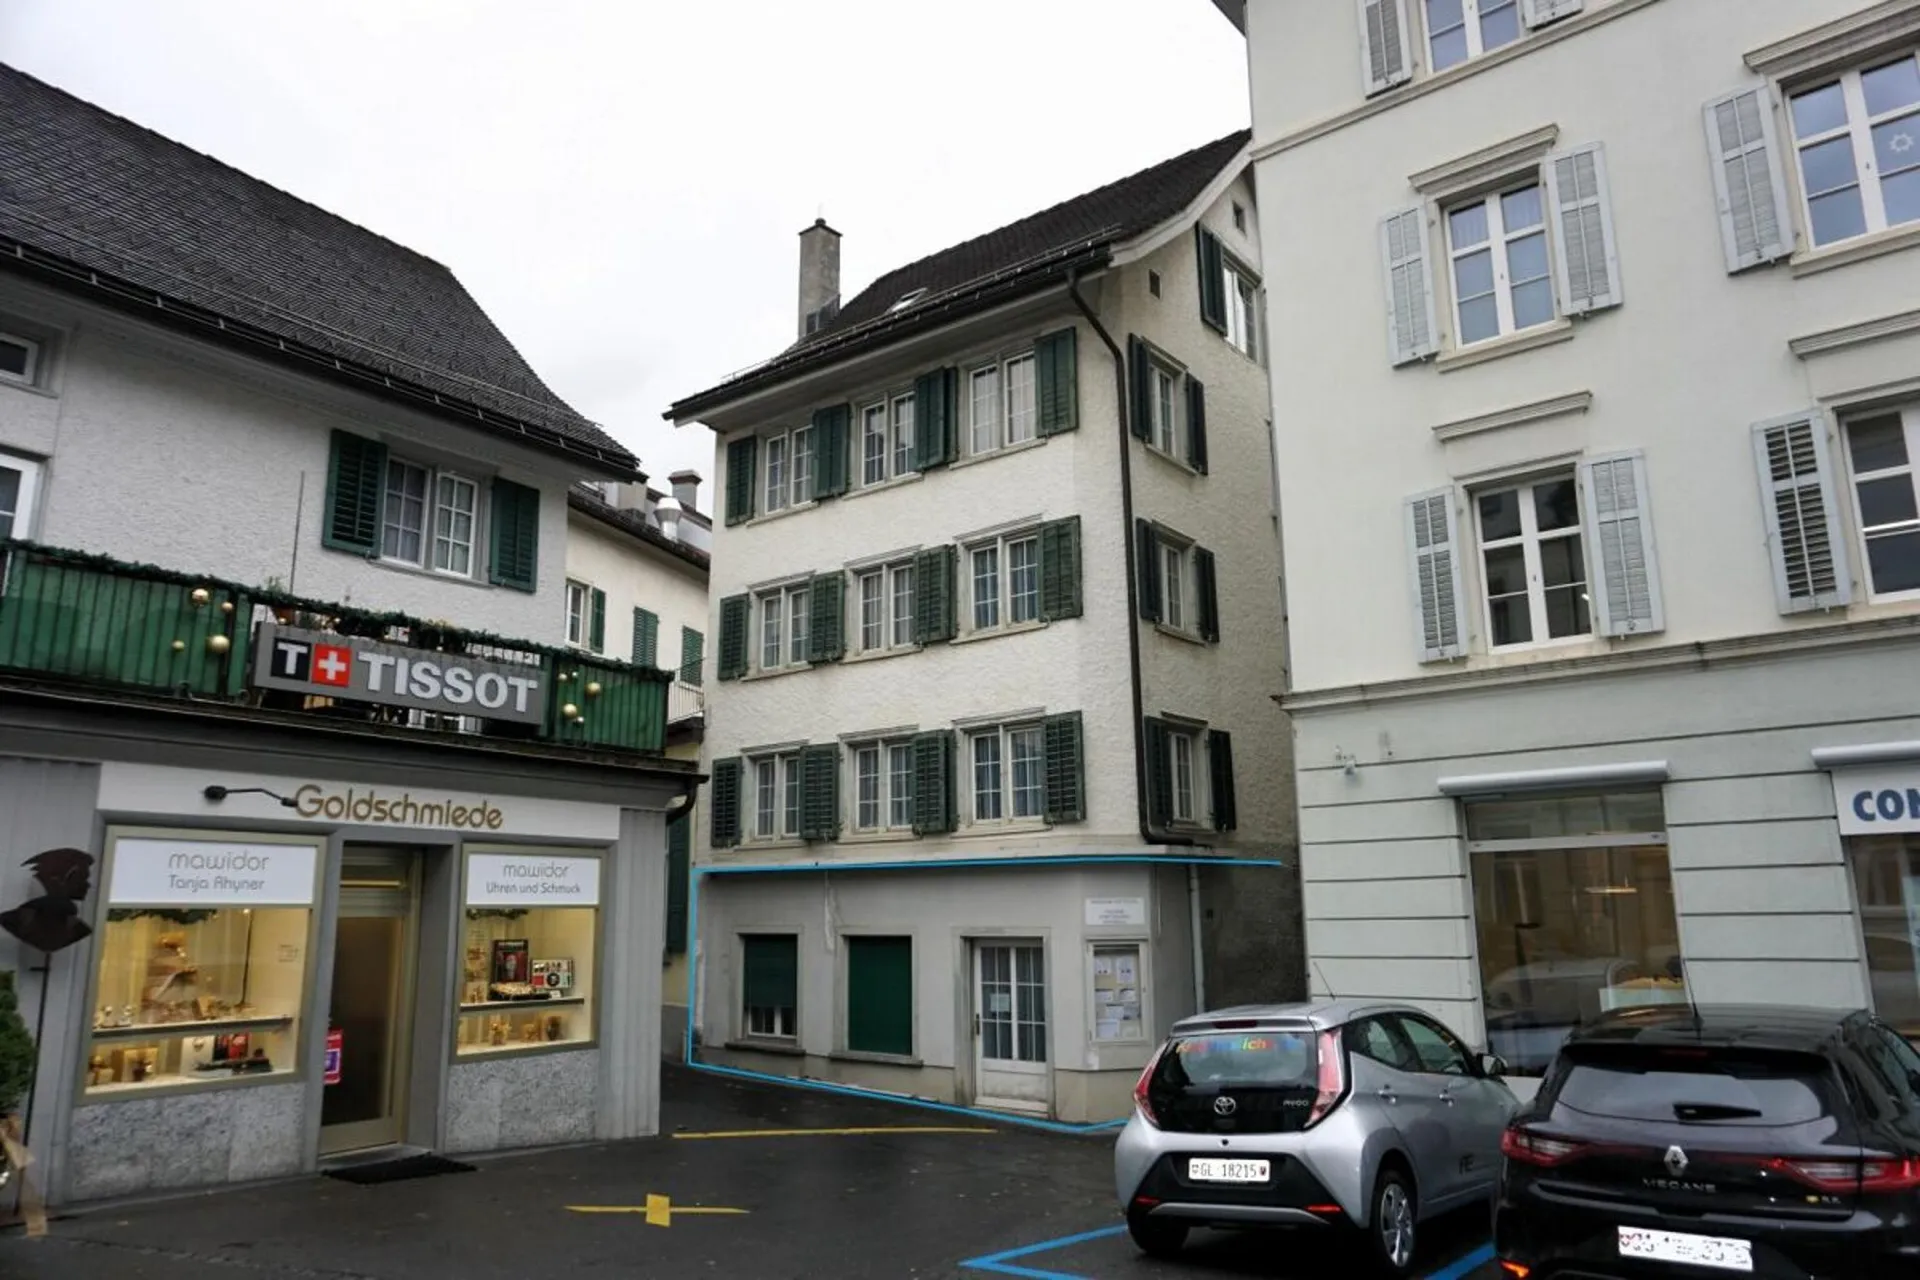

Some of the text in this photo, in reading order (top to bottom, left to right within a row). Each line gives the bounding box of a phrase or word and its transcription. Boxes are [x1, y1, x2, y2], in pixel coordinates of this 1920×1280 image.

[357, 652, 539, 714] TISSOT
[295, 784, 504, 829] Goldschmiede
[168, 850, 270, 872] mawidor
[503, 862, 569, 878] mawidor
[168, 874, 209, 893] Tanja
[486, 881, 581, 895] Uhren und Schmuck
[1200, 1163, 1257, 1179] GL 18215
